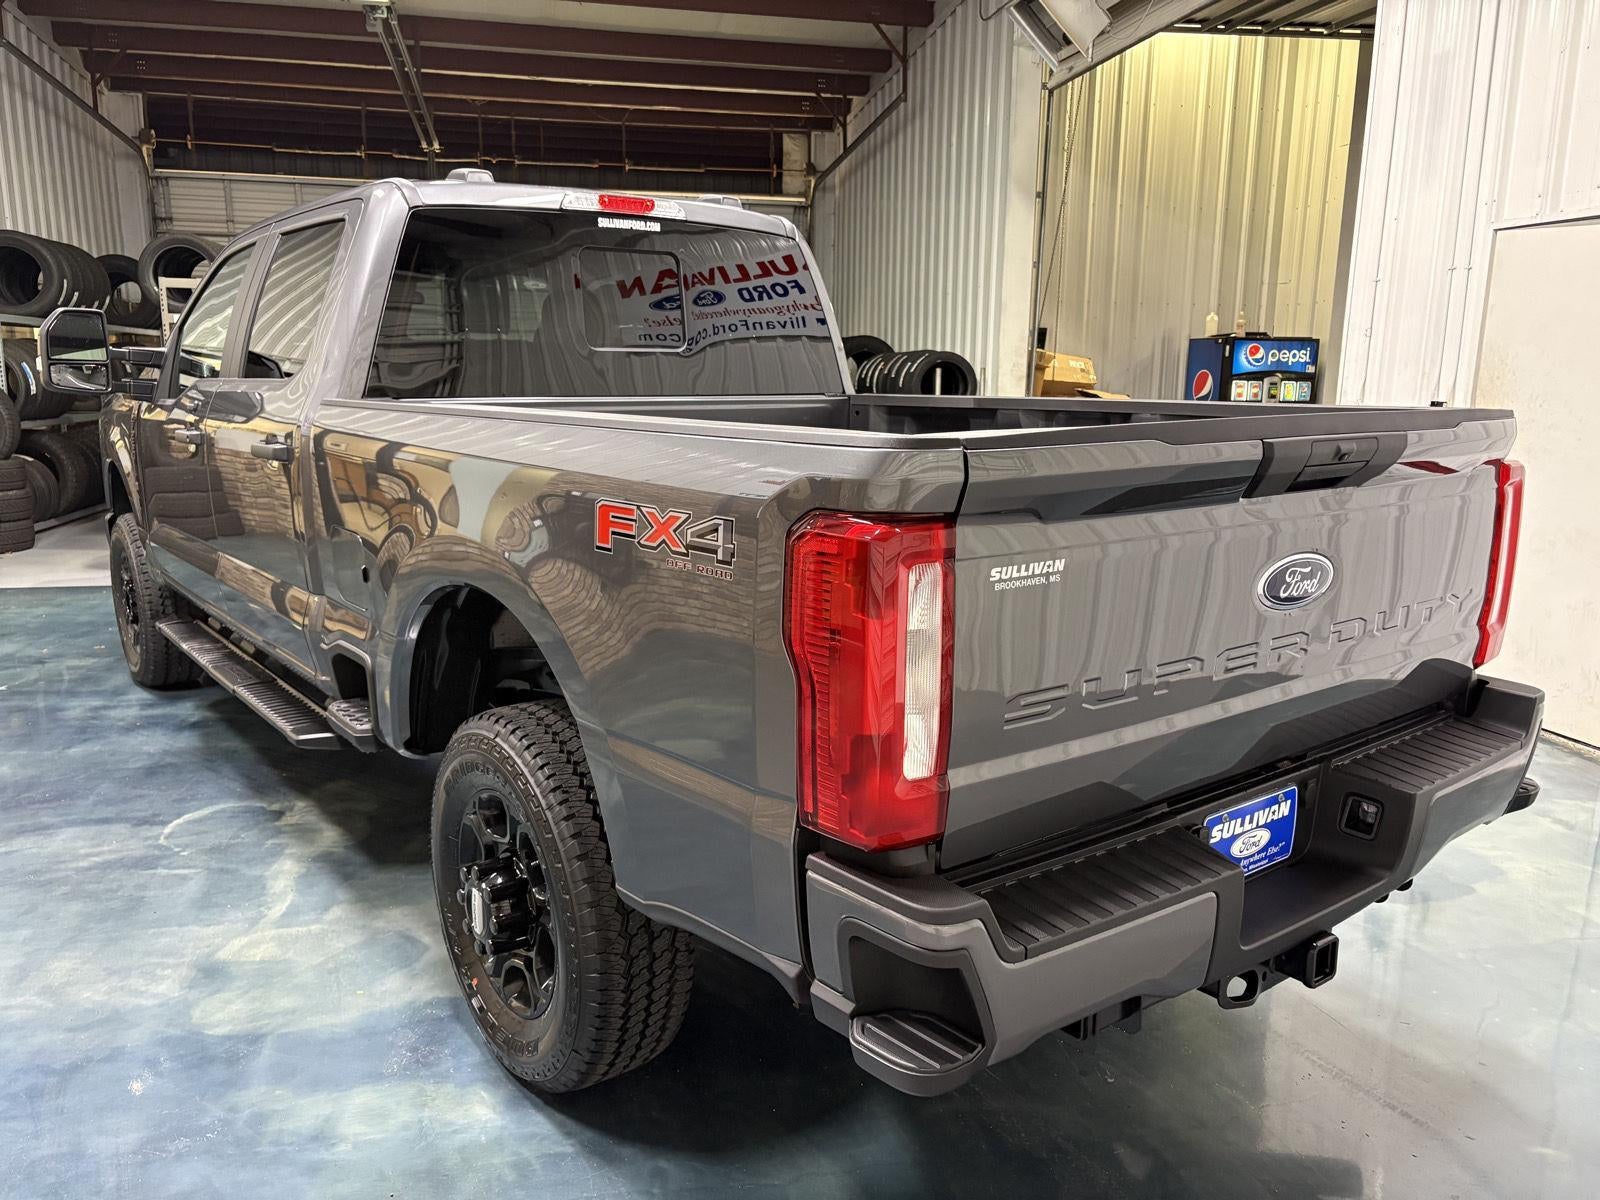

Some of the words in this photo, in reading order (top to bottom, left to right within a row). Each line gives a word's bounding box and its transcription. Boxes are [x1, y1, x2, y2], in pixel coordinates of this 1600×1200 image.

[597, 216, 661, 232] SULLIVANFORD.COM
[1268, 347, 1311, 366] pepsi
[594, 497, 736, 568] FX4
[665, 558, 693, 571] OFF
[696, 564, 733, 580] ROAD
[989, 558, 1066, 582] SULLIVAN
[994, 576, 1048, 591] BROOKHAVEN,
[1049, 573, 1061, 583] MS
[1279, 566, 1321, 599] Ford
[1003, 632, 1310, 730] SUPER
[1328, 588, 1473, 651] DUTY
[1209, 799, 1292, 844] SULLIVAN
[1238, 833, 1263, 853] Ford
